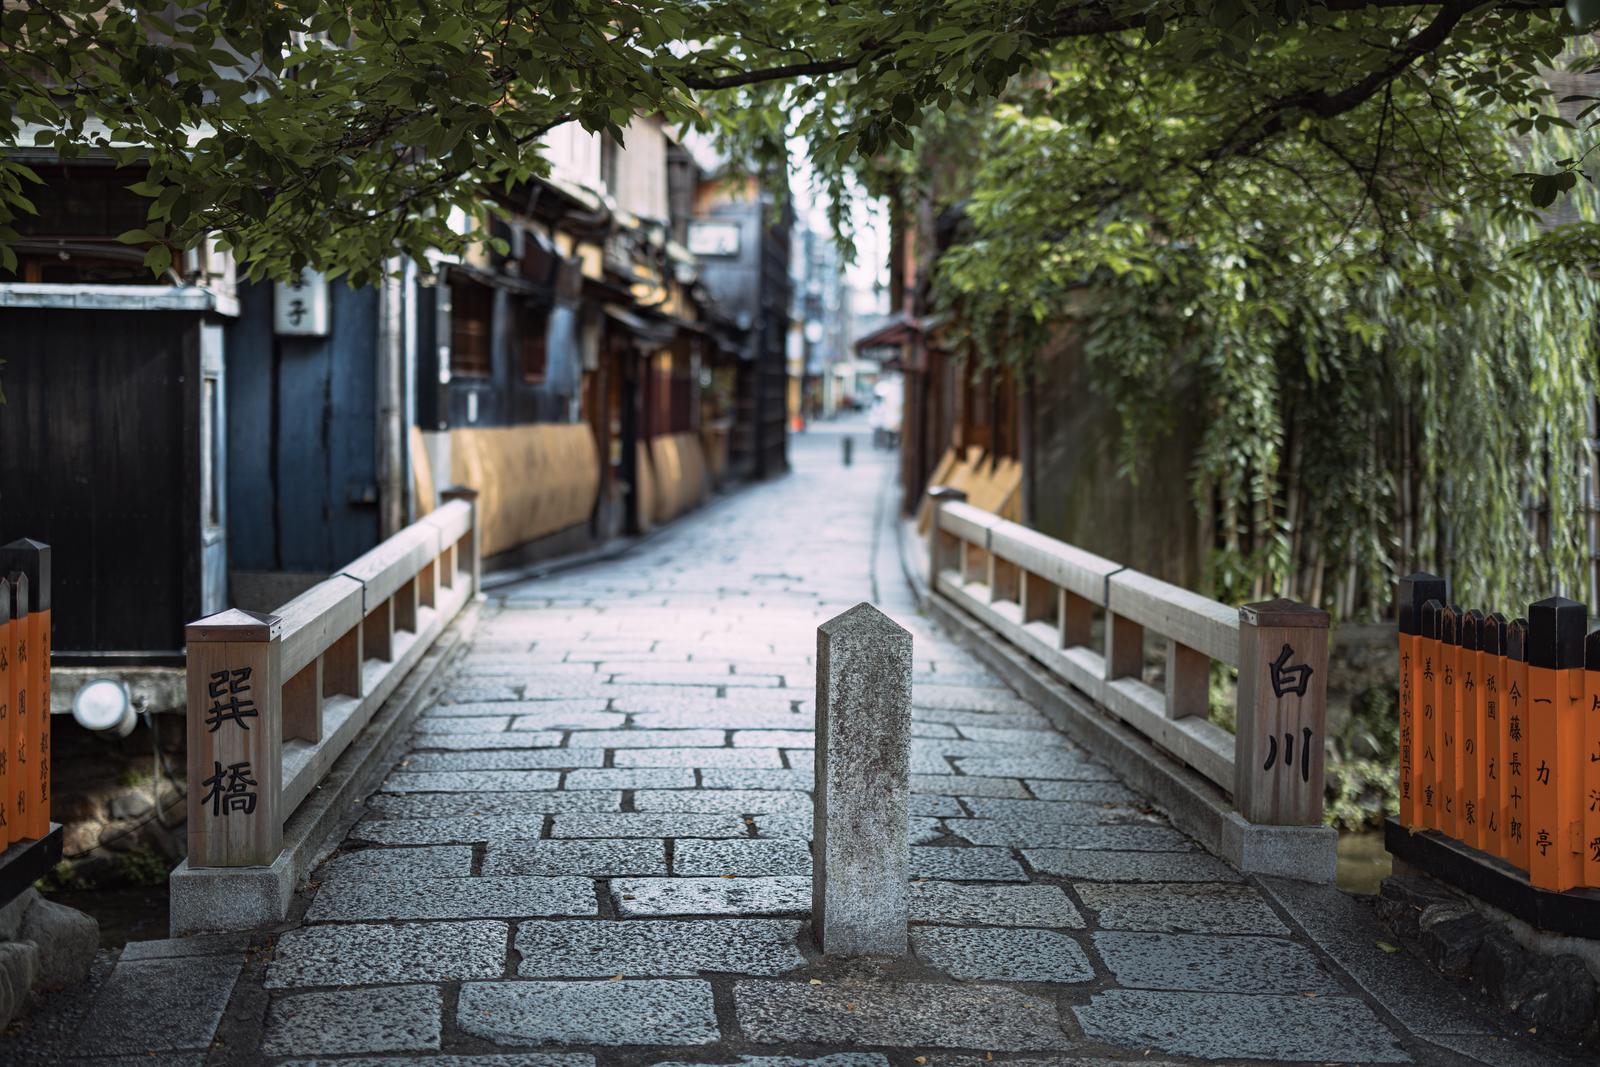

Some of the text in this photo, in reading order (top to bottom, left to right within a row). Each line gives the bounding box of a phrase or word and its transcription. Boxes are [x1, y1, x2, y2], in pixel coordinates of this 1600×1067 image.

[201, 666, 259, 817] 巽橋
[1263, 642, 1314, 783] 白川
[1423, 656, 1434, 808] 美の八重
[1444, 664, 1453, 813] おいと
[1464, 671, 1475, 825] みの家
[1508, 680, 1522, 845] 今藤長十郎
[1533, 697, 1553, 857] 一力亭
